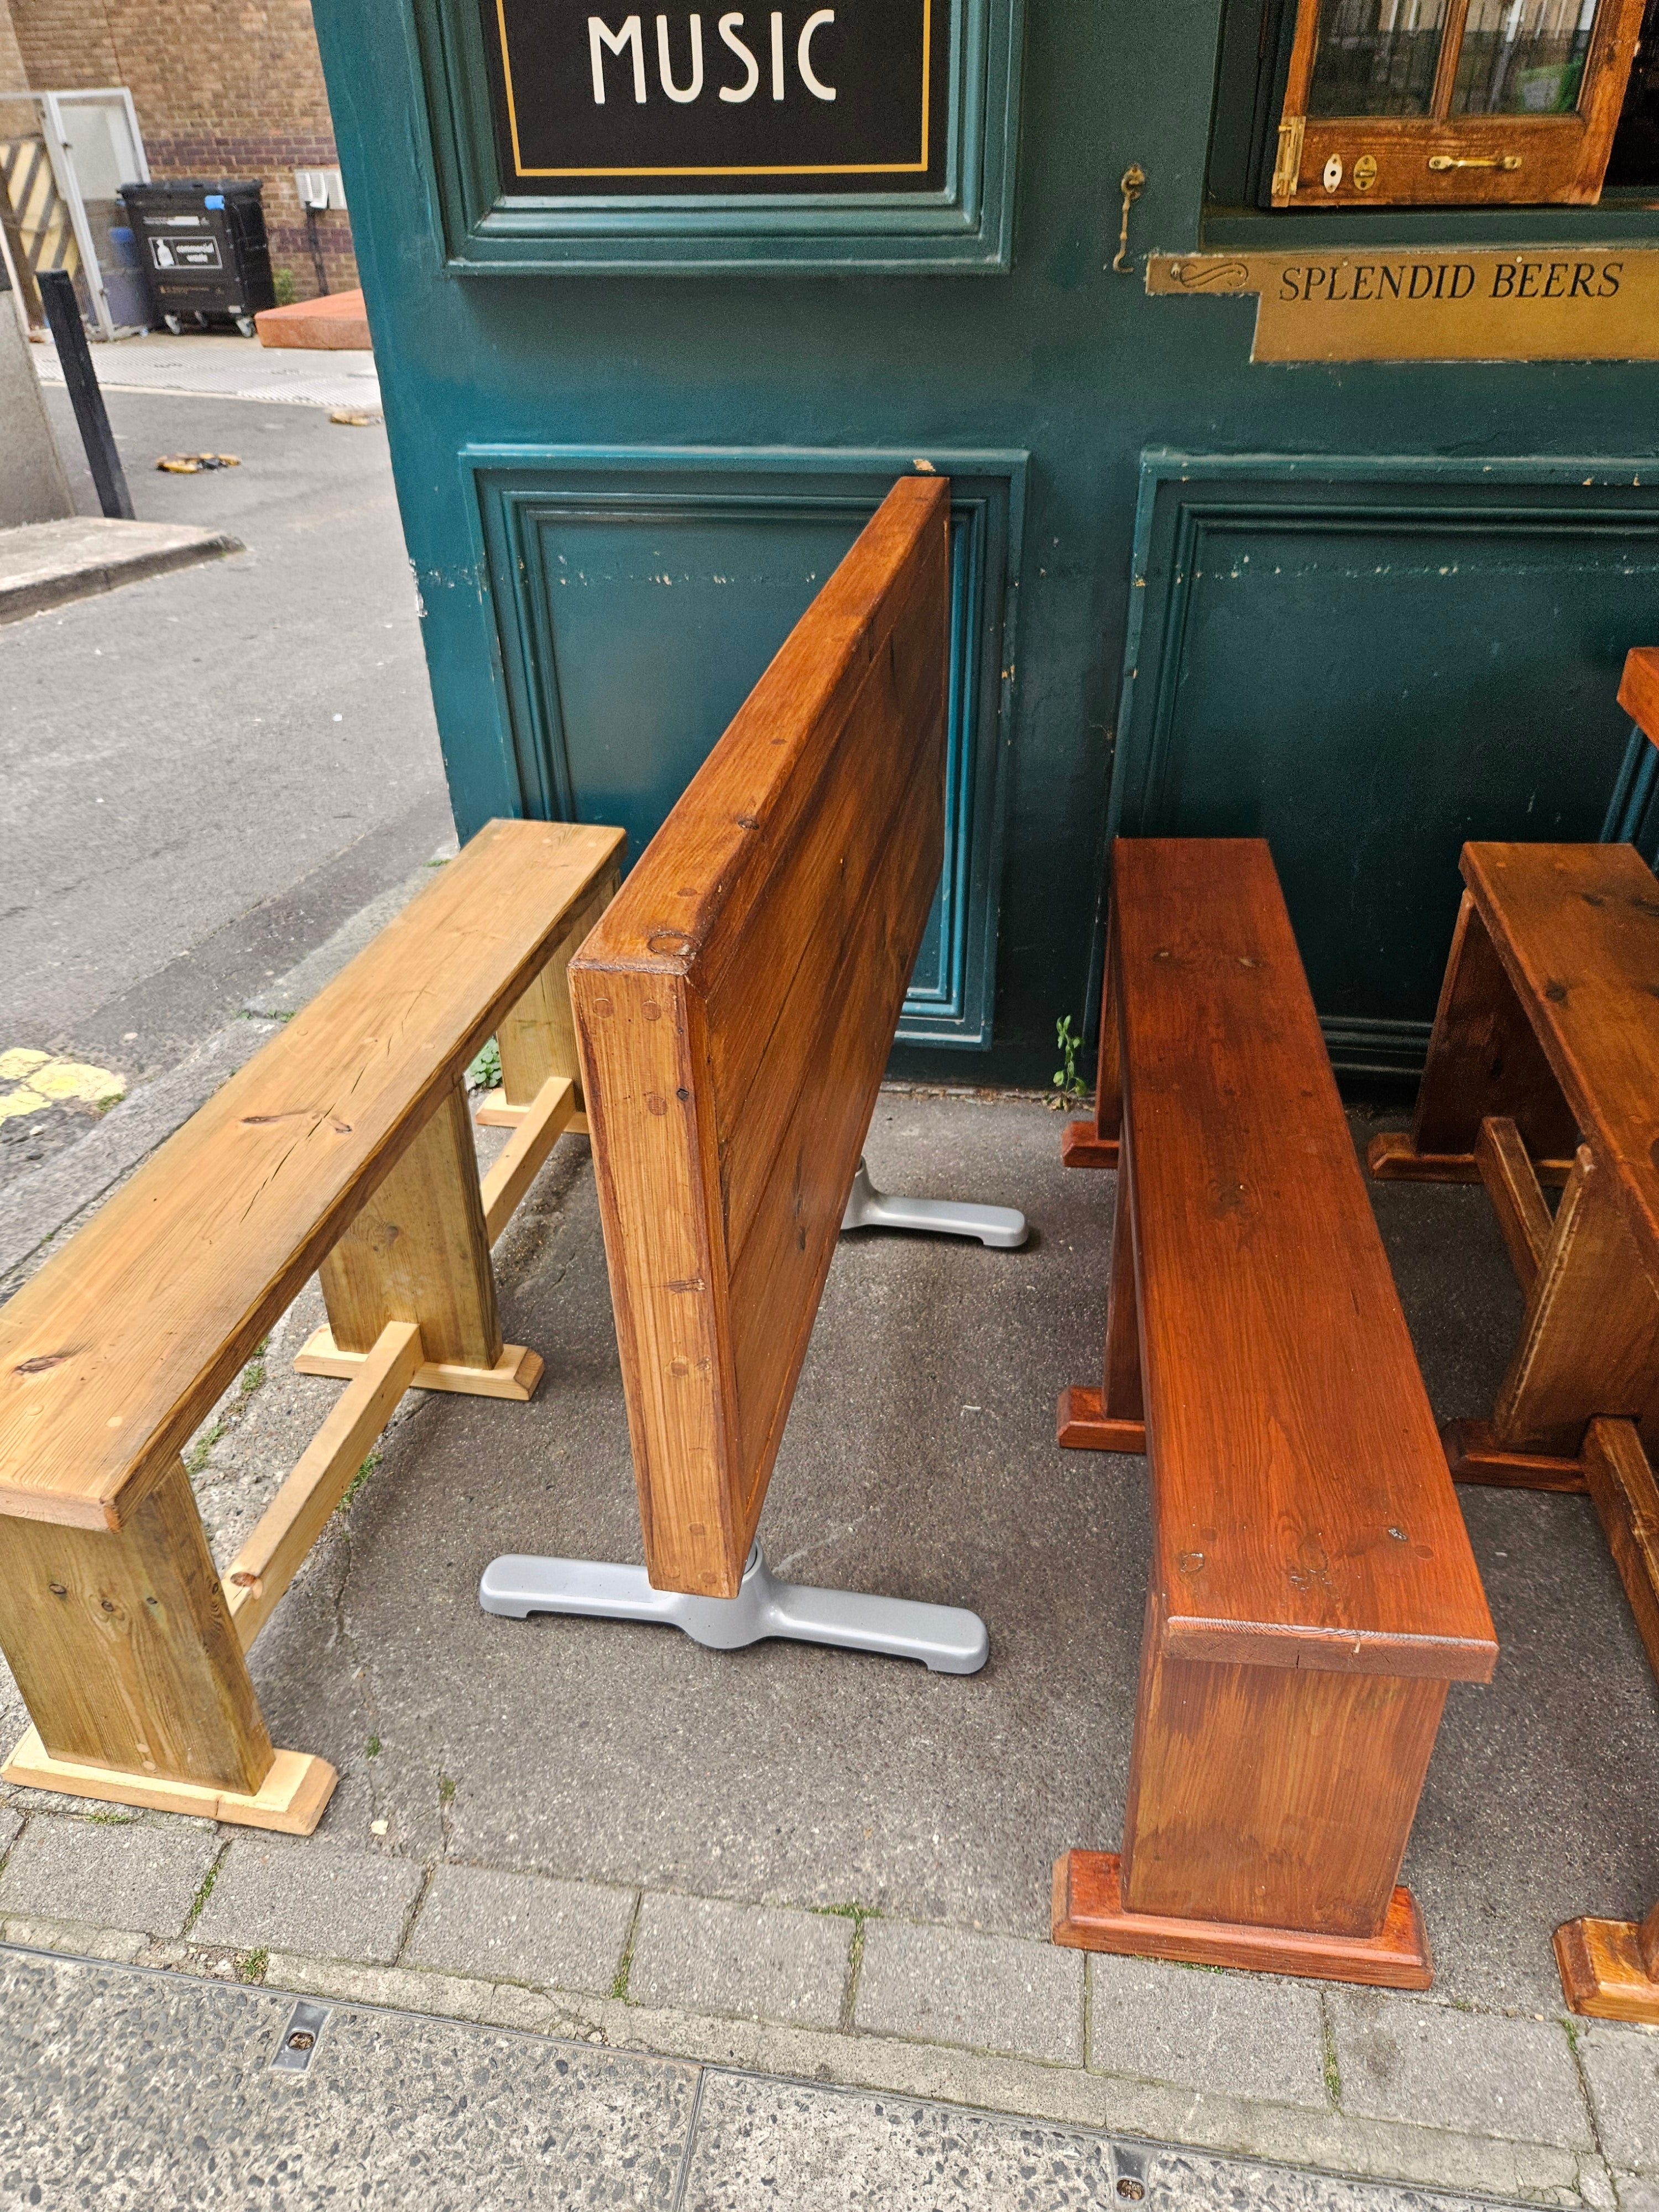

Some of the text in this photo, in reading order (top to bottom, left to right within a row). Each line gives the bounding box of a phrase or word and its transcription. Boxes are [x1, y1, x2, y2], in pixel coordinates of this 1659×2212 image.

[588, 9, 837, 105] MUSIC
[1279, 262, 1624, 301] SPLENDID BEERS
